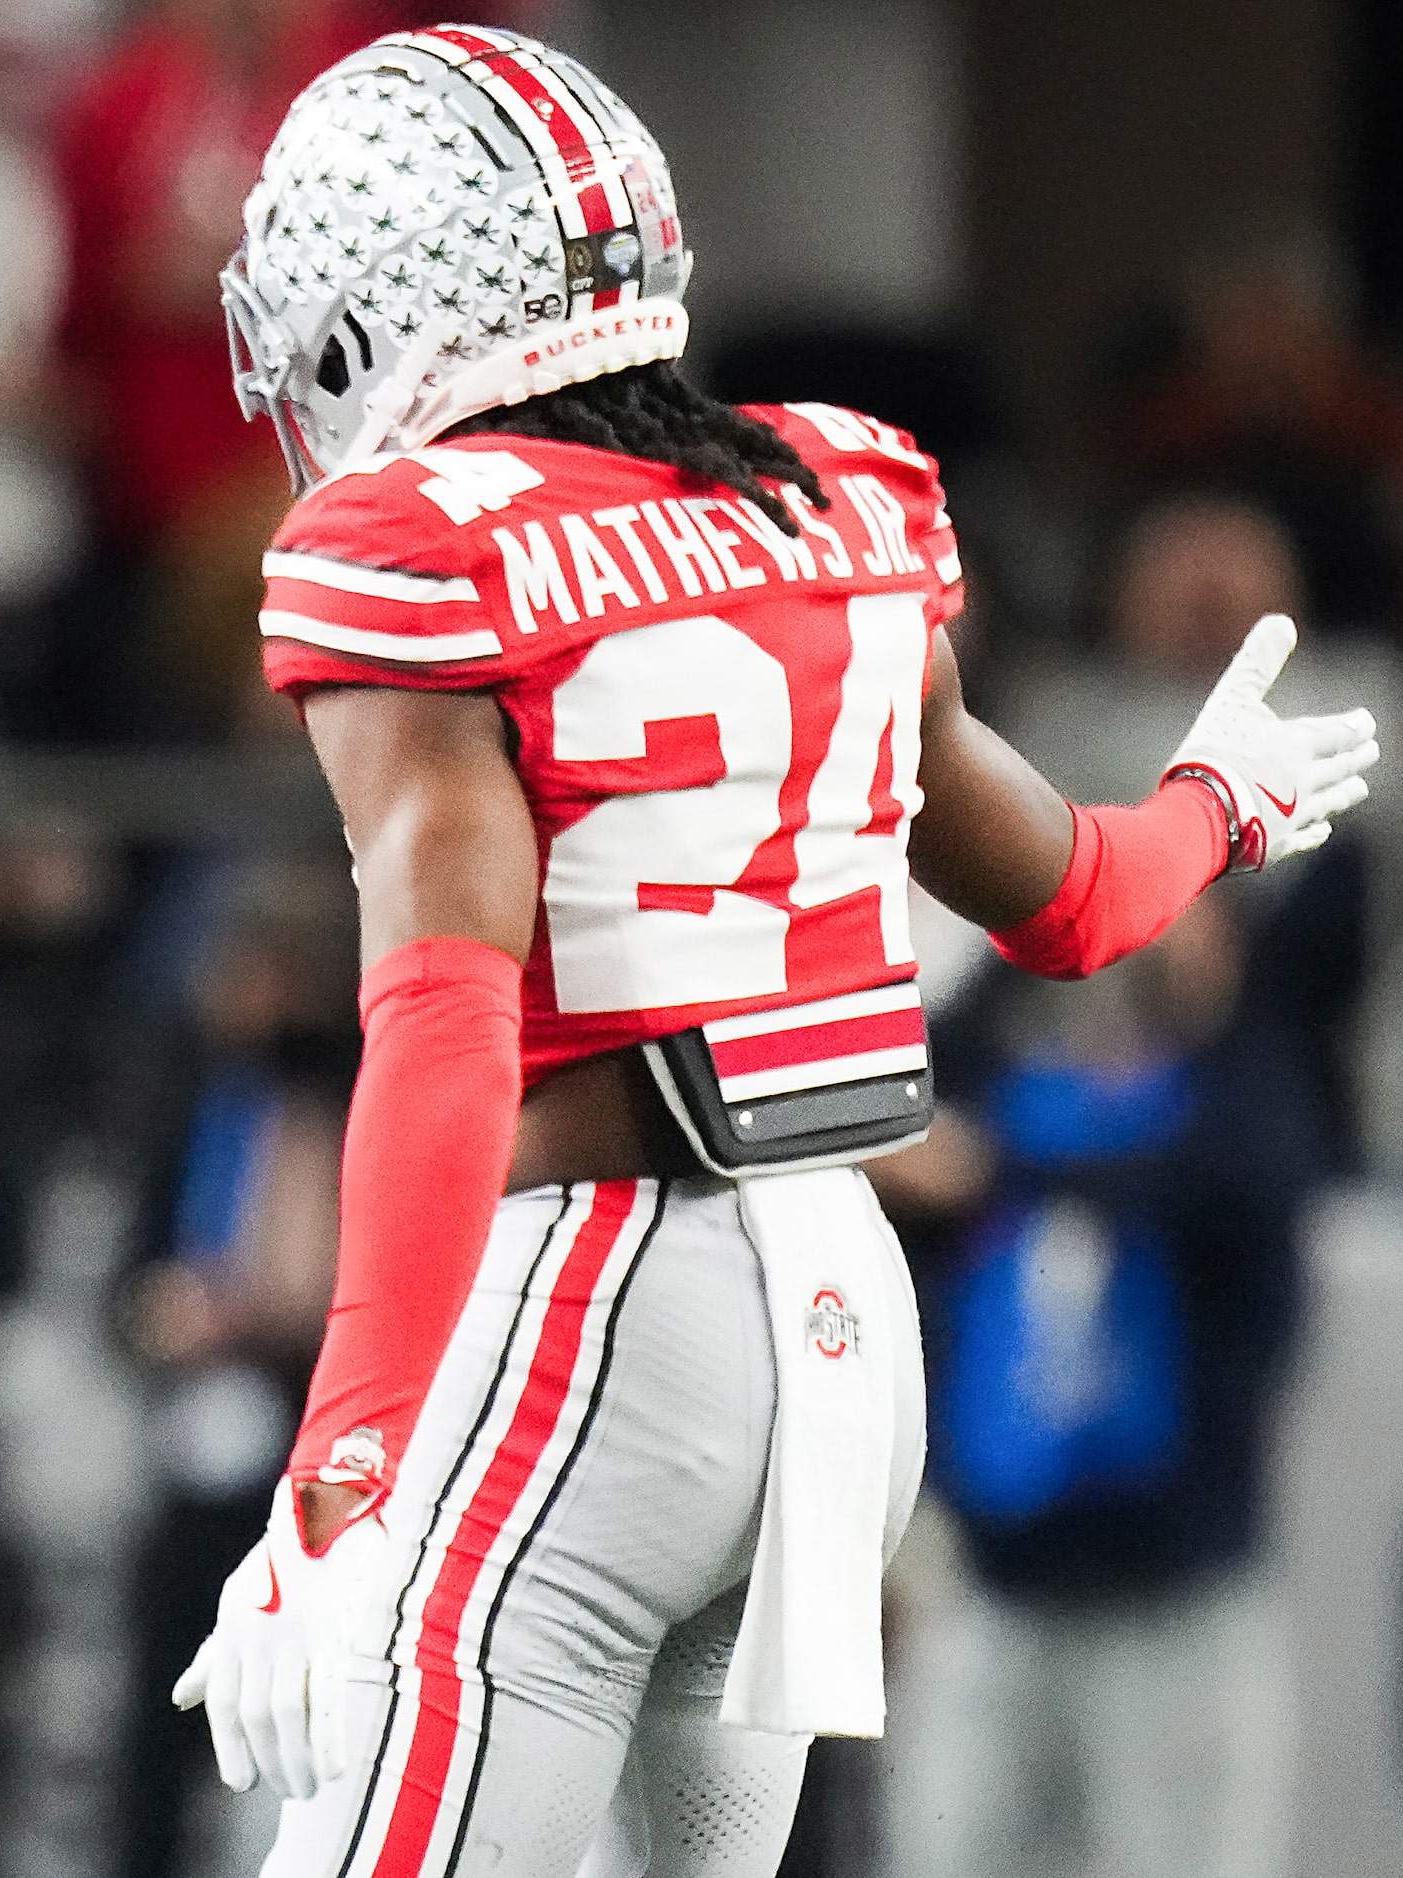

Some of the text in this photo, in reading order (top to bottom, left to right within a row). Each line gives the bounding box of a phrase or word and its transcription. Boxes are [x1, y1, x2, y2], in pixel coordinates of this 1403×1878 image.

[524, 316, 674, 366] BUCKEYES
[491, 474, 926, 635] MATHEWS JR.
[543, 592, 928, 1015] 24
